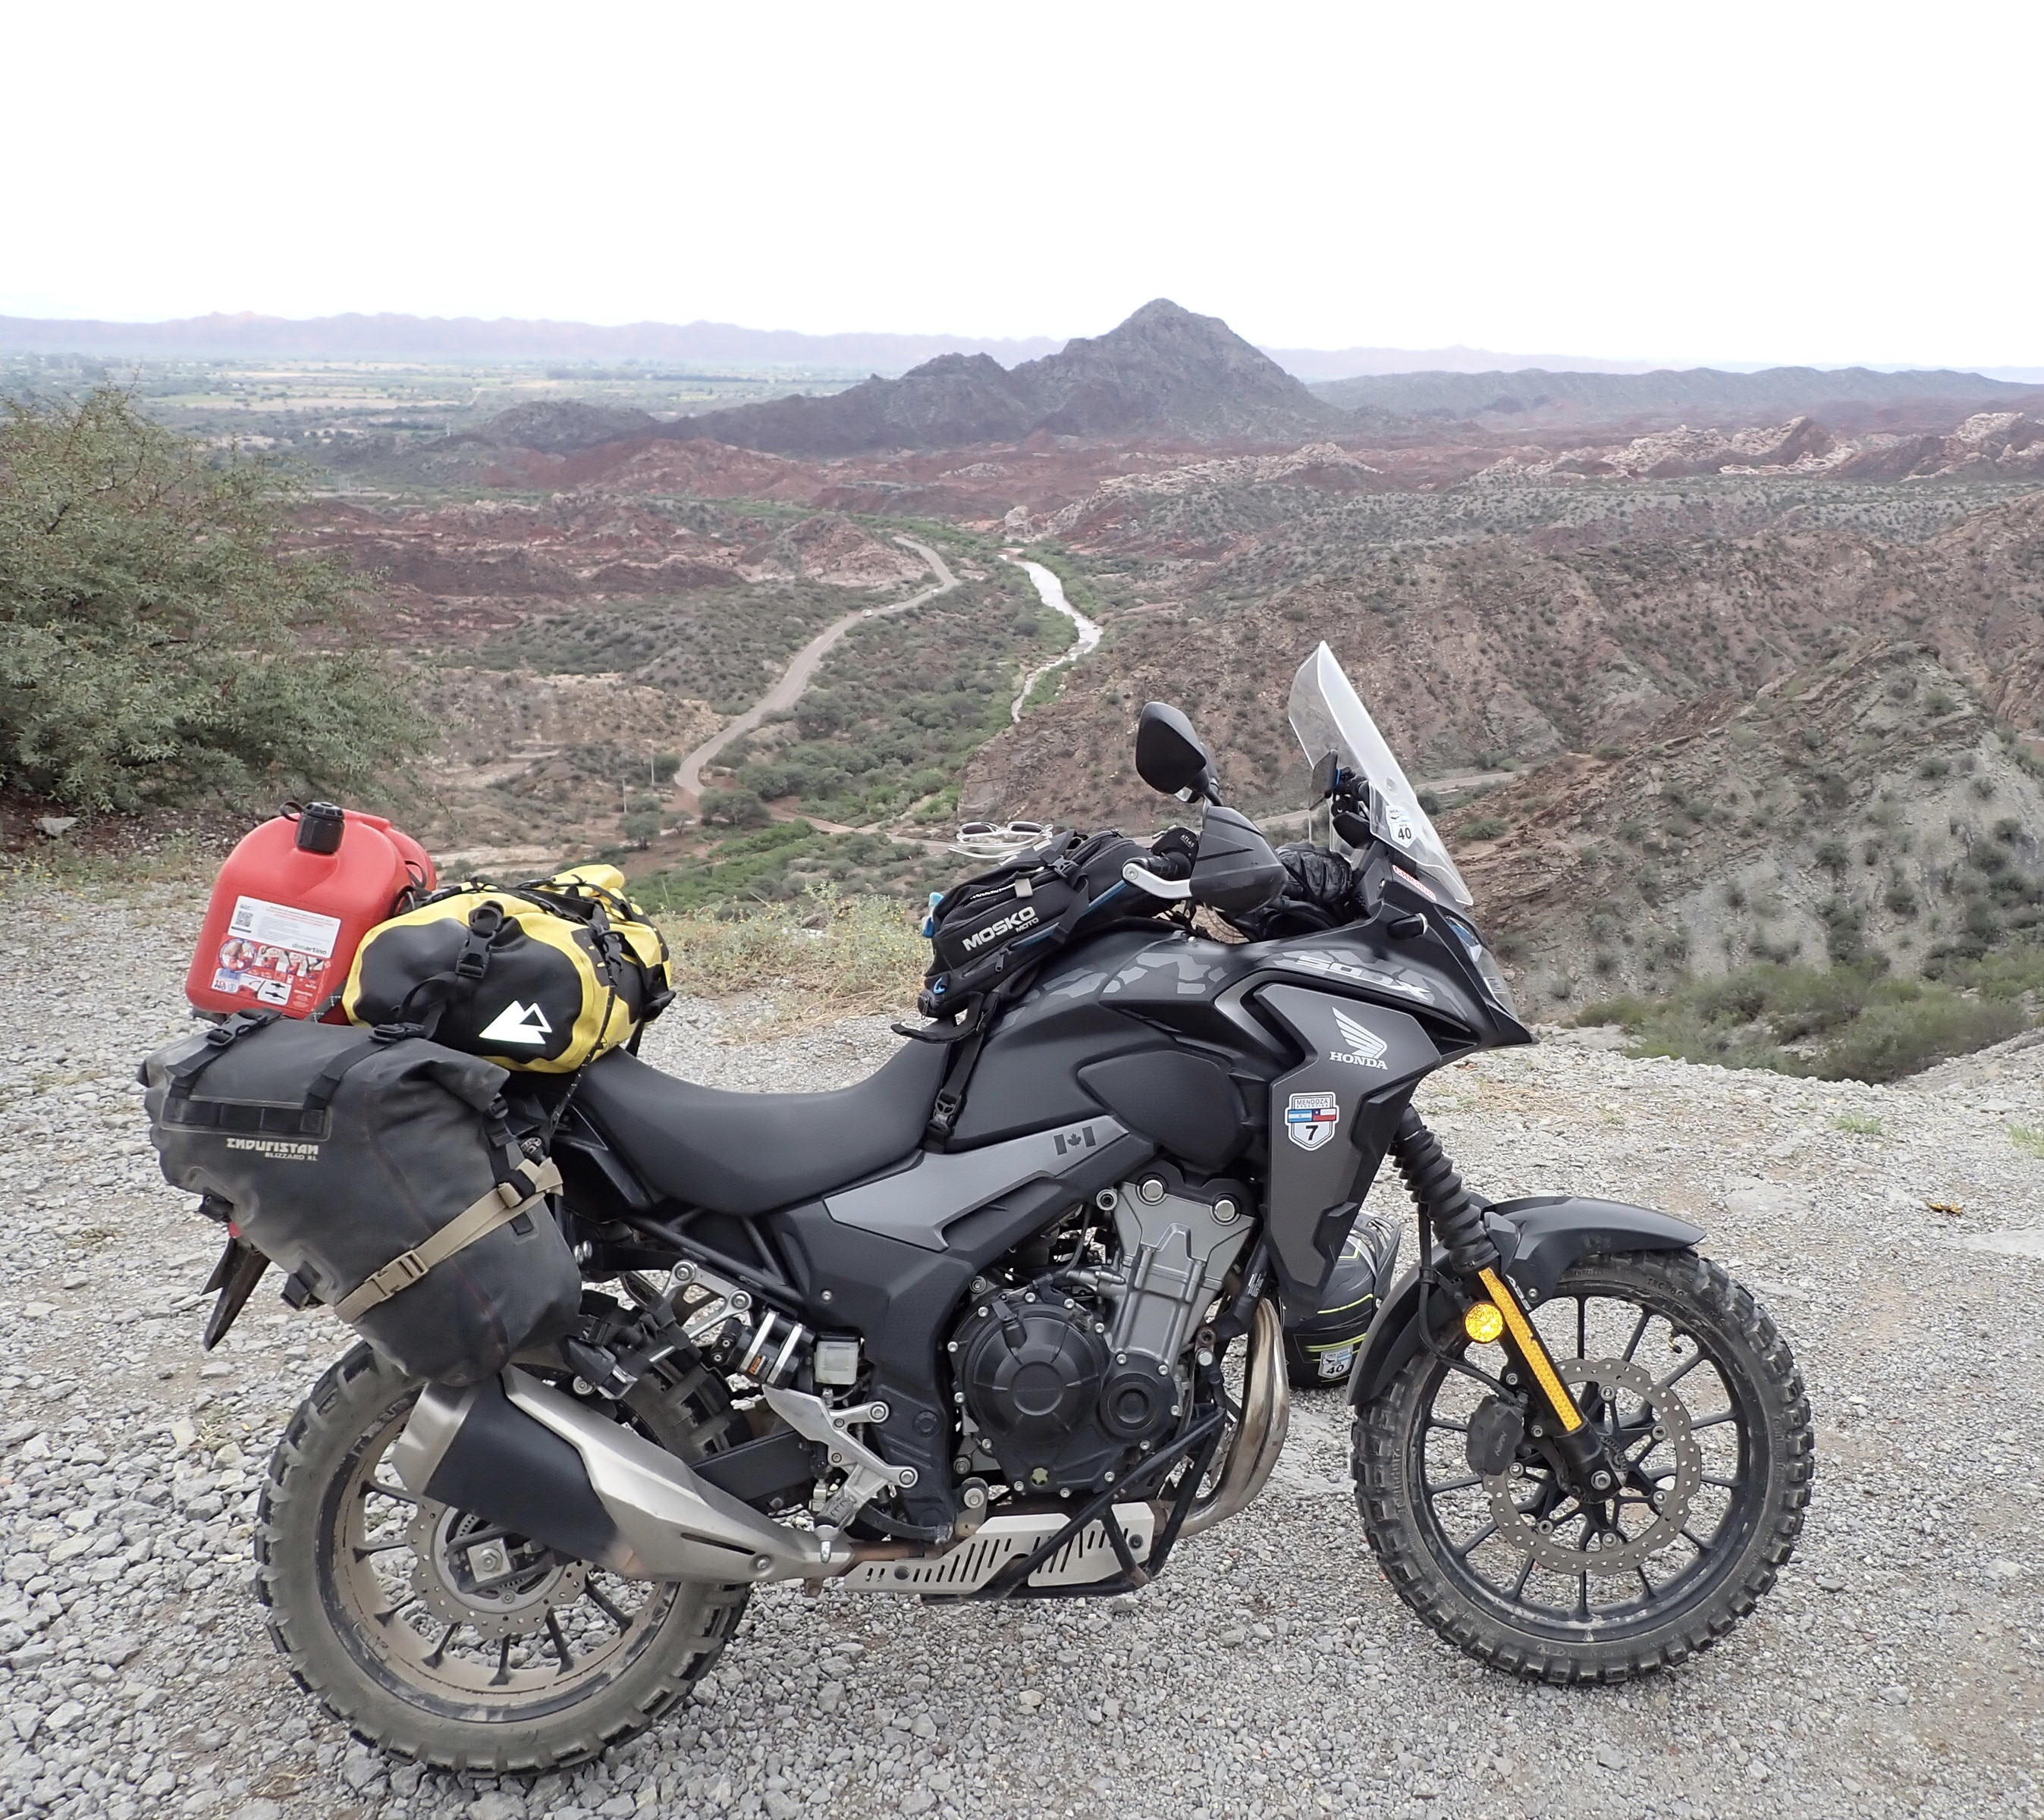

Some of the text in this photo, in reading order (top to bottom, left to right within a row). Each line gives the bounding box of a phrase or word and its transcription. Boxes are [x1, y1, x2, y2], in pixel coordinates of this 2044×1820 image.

[1398, 827, 1411, 840] 40
[962, 906, 1035, 952] MOSKO
[1015, 917, 1039, 933] MOTO
[1295, 955, 1431, 1001] 500X
[1329, 1051, 1389, 1070] HONDA
[1305, 1125, 1319, 1141] 7
[226, 1138, 319, 1155] ENDURISTAN
[265, 1152, 305, 1161] BLIZZARD
[1326, 1364, 1345, 1374] 40
